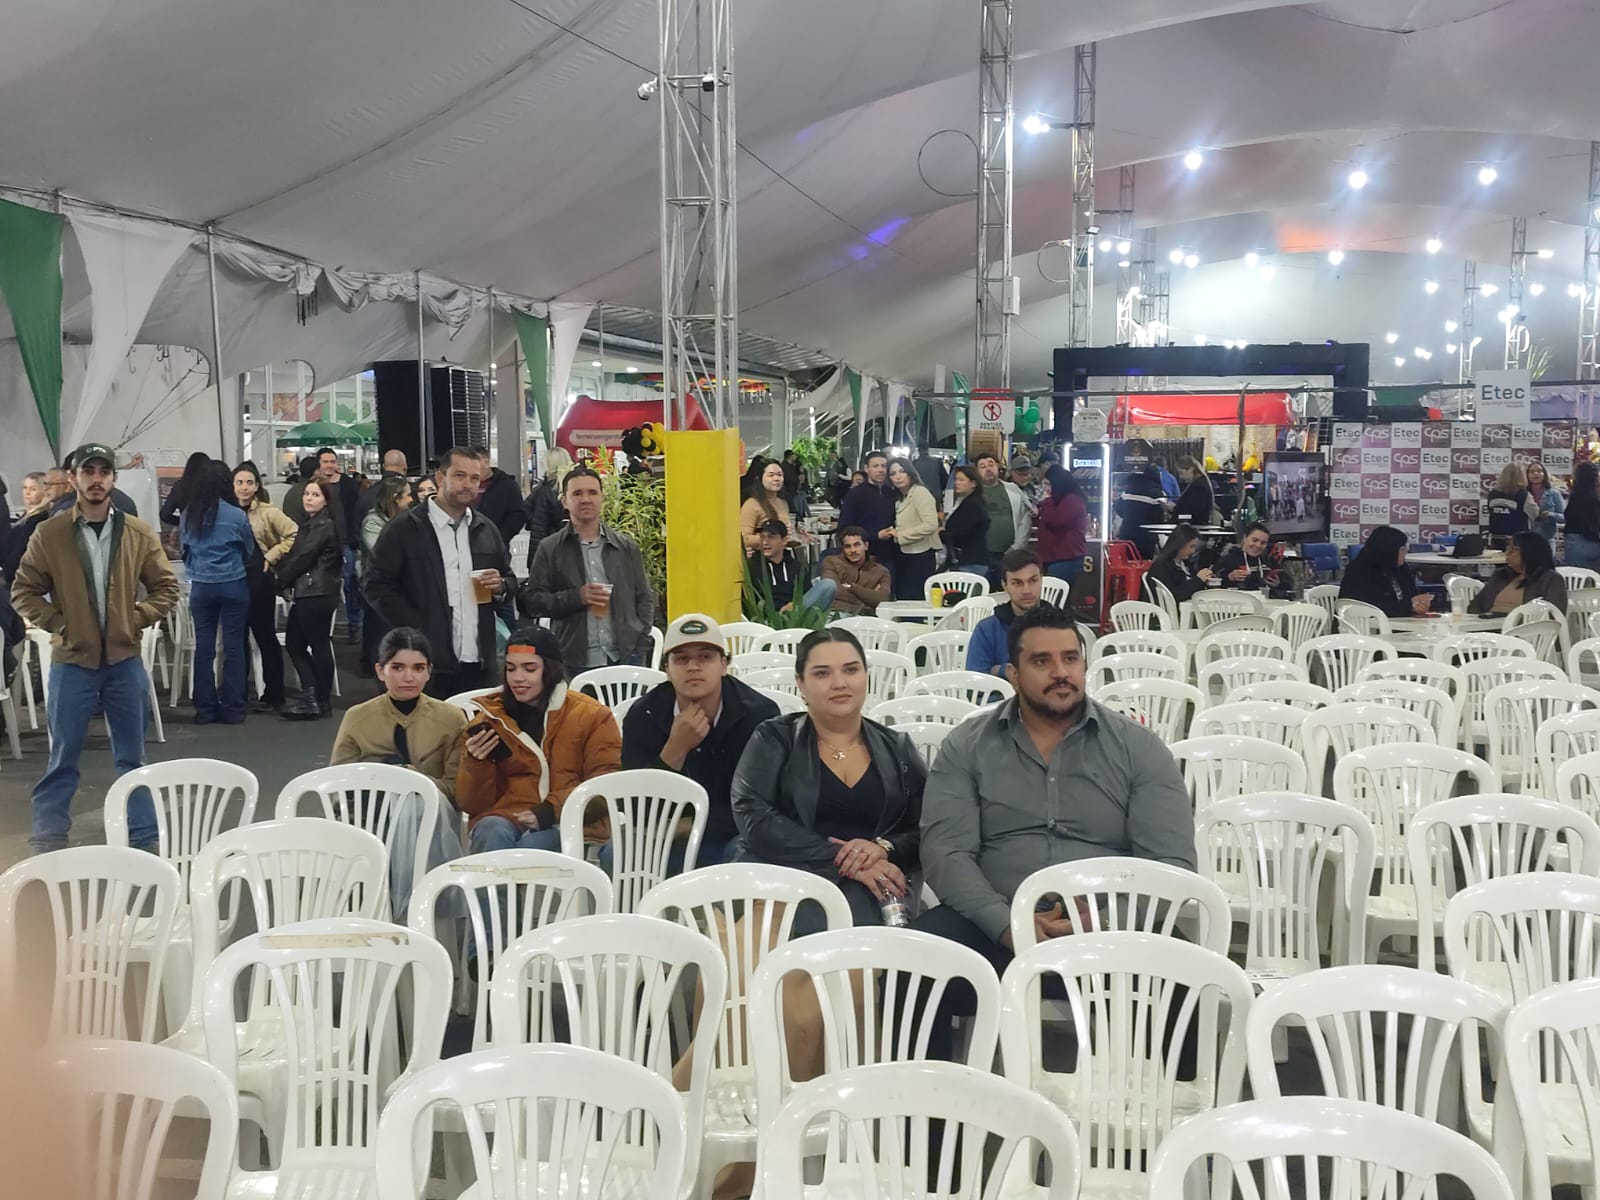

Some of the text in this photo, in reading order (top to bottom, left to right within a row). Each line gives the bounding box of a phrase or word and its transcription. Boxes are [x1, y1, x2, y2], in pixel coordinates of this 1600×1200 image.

[1481, 384, 1525, 400] Etec
[1335, 427, 1361, 438] Etec
[1393, 427, 1420, 438] Etec
[1453, 427, 1480, 438] Etec
[1514, 427, 1540, 438] Etec
[1363, 453, 1390, 463] Etec
[1422, 453, 1449, 463] Etec
[1483, 453, 1509, 463] Etec
[1543, 454, 1570, 464] Etec
[1334, 479, 1360, 488] Etec
[1392, 479, 1418, 489] Etec
[1452, 479, 1479, 489] Etec
[1362, 504, 1388, 514] Etec
[1421, 504, 1448, 514] Etec
[1333, 529, 1359, 539] Etec
